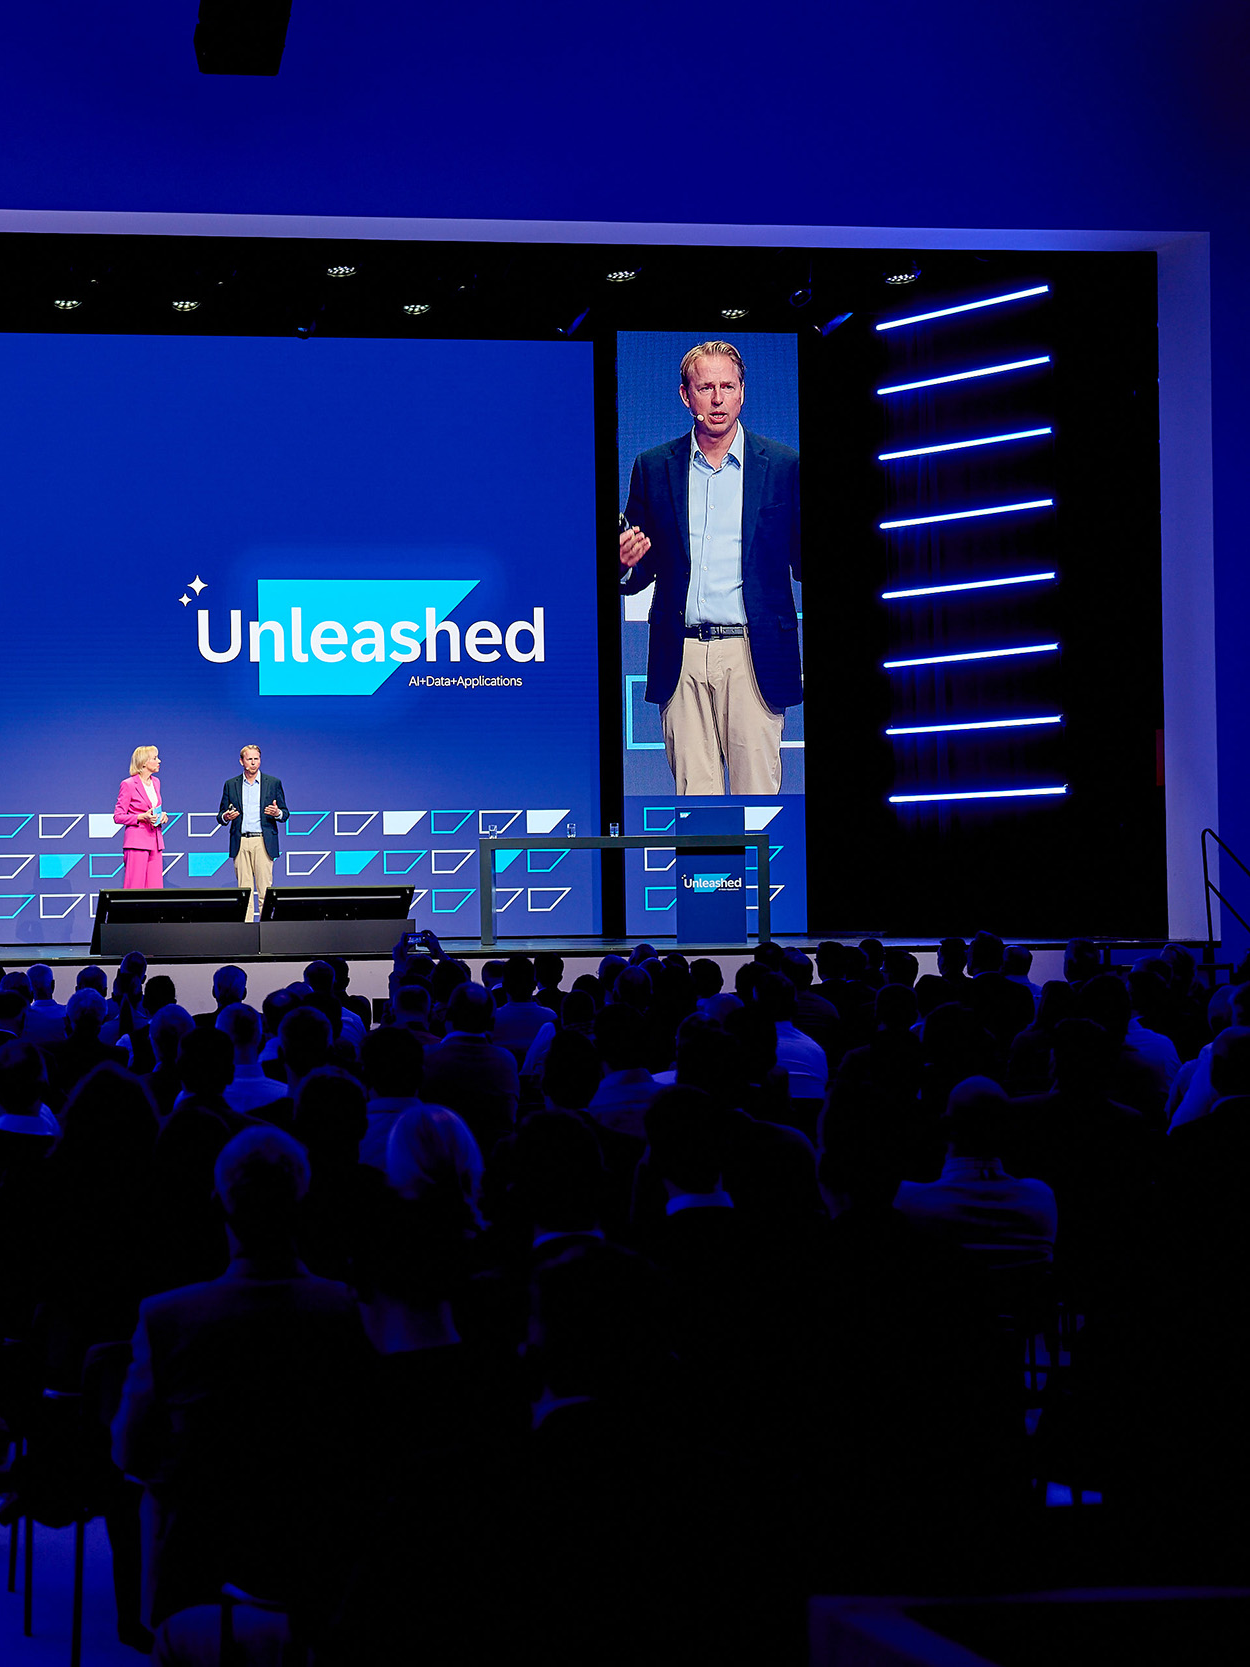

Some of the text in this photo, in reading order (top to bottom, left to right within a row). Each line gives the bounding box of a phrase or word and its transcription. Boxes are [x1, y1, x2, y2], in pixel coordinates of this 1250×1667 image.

[197, 607, 546, 664] Unleashed
[408, 675, 523, 689] AI+Data+Applications
[684, 877, 742, 888] Unleashed
